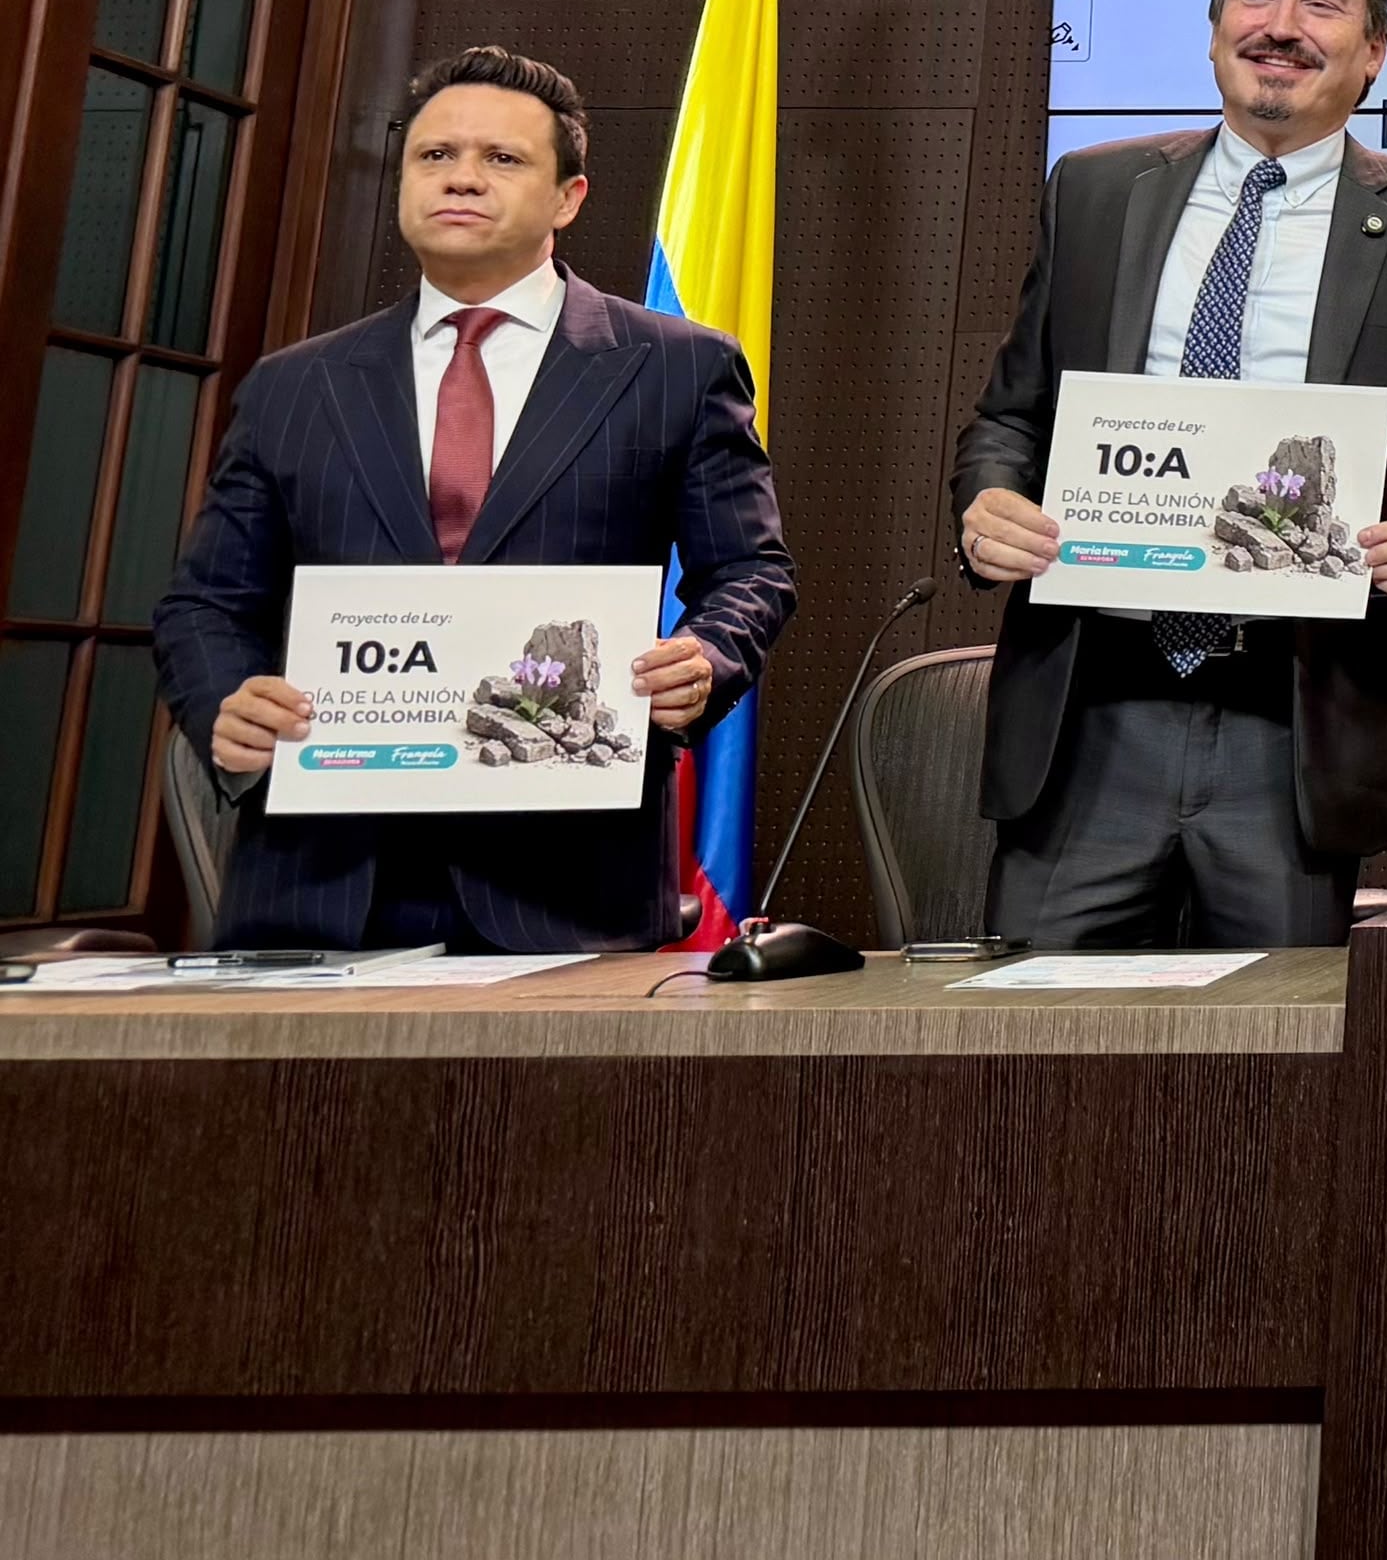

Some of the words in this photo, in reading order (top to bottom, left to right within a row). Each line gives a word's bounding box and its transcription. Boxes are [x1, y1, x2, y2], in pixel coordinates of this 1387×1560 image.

[1092, 417, 1155, 431] Proyecto
[1158, 420, 1176, 431] de
[1177, 421, 1206, 435] Ley:
[1096, 443, 1190, 479] 10:A
[1062, 487, 1093, 503] DÍA
[1098, 491, 1123, 504] DE
[1128, 493, 1150, 506] LA
[1155, 493, 1215, 509] UNIÓN
[1064, 508, 1103, 522] POR
[331, 612, 398, 627] Proyecto
[400, 612, 420, 624] de
[422, 612, 453, 626] Ley:
[336, 640, 438, 674] 10:A
[340, 690, 367, 704] DE
[372, 690, 395, 704] LA
[401, 687, 465, 704] UNIÓN
